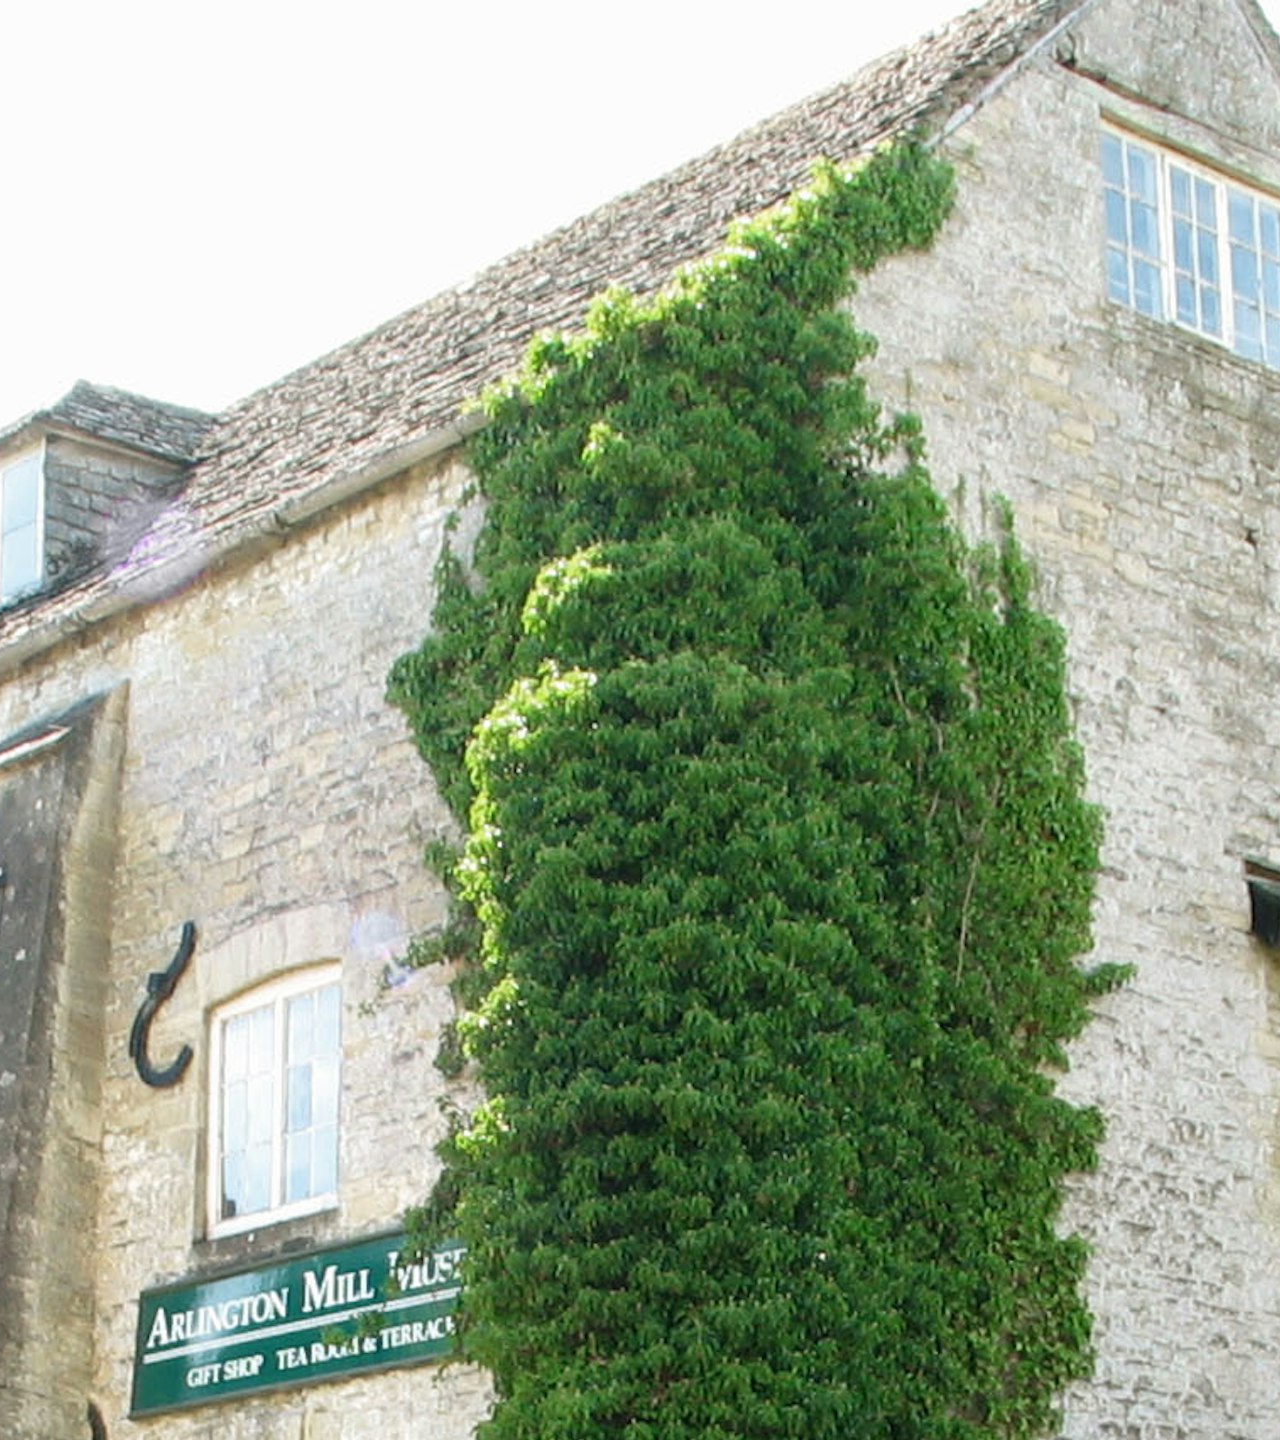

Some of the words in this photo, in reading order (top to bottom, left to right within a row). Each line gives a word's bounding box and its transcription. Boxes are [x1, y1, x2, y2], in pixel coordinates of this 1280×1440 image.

[186, 1363, 222, 1387] GIFT
[223, 1354, 264, 1380] SHOP
[276, 1346, 308, 1370] TEA
[362, 1337, 377, 1353] &
